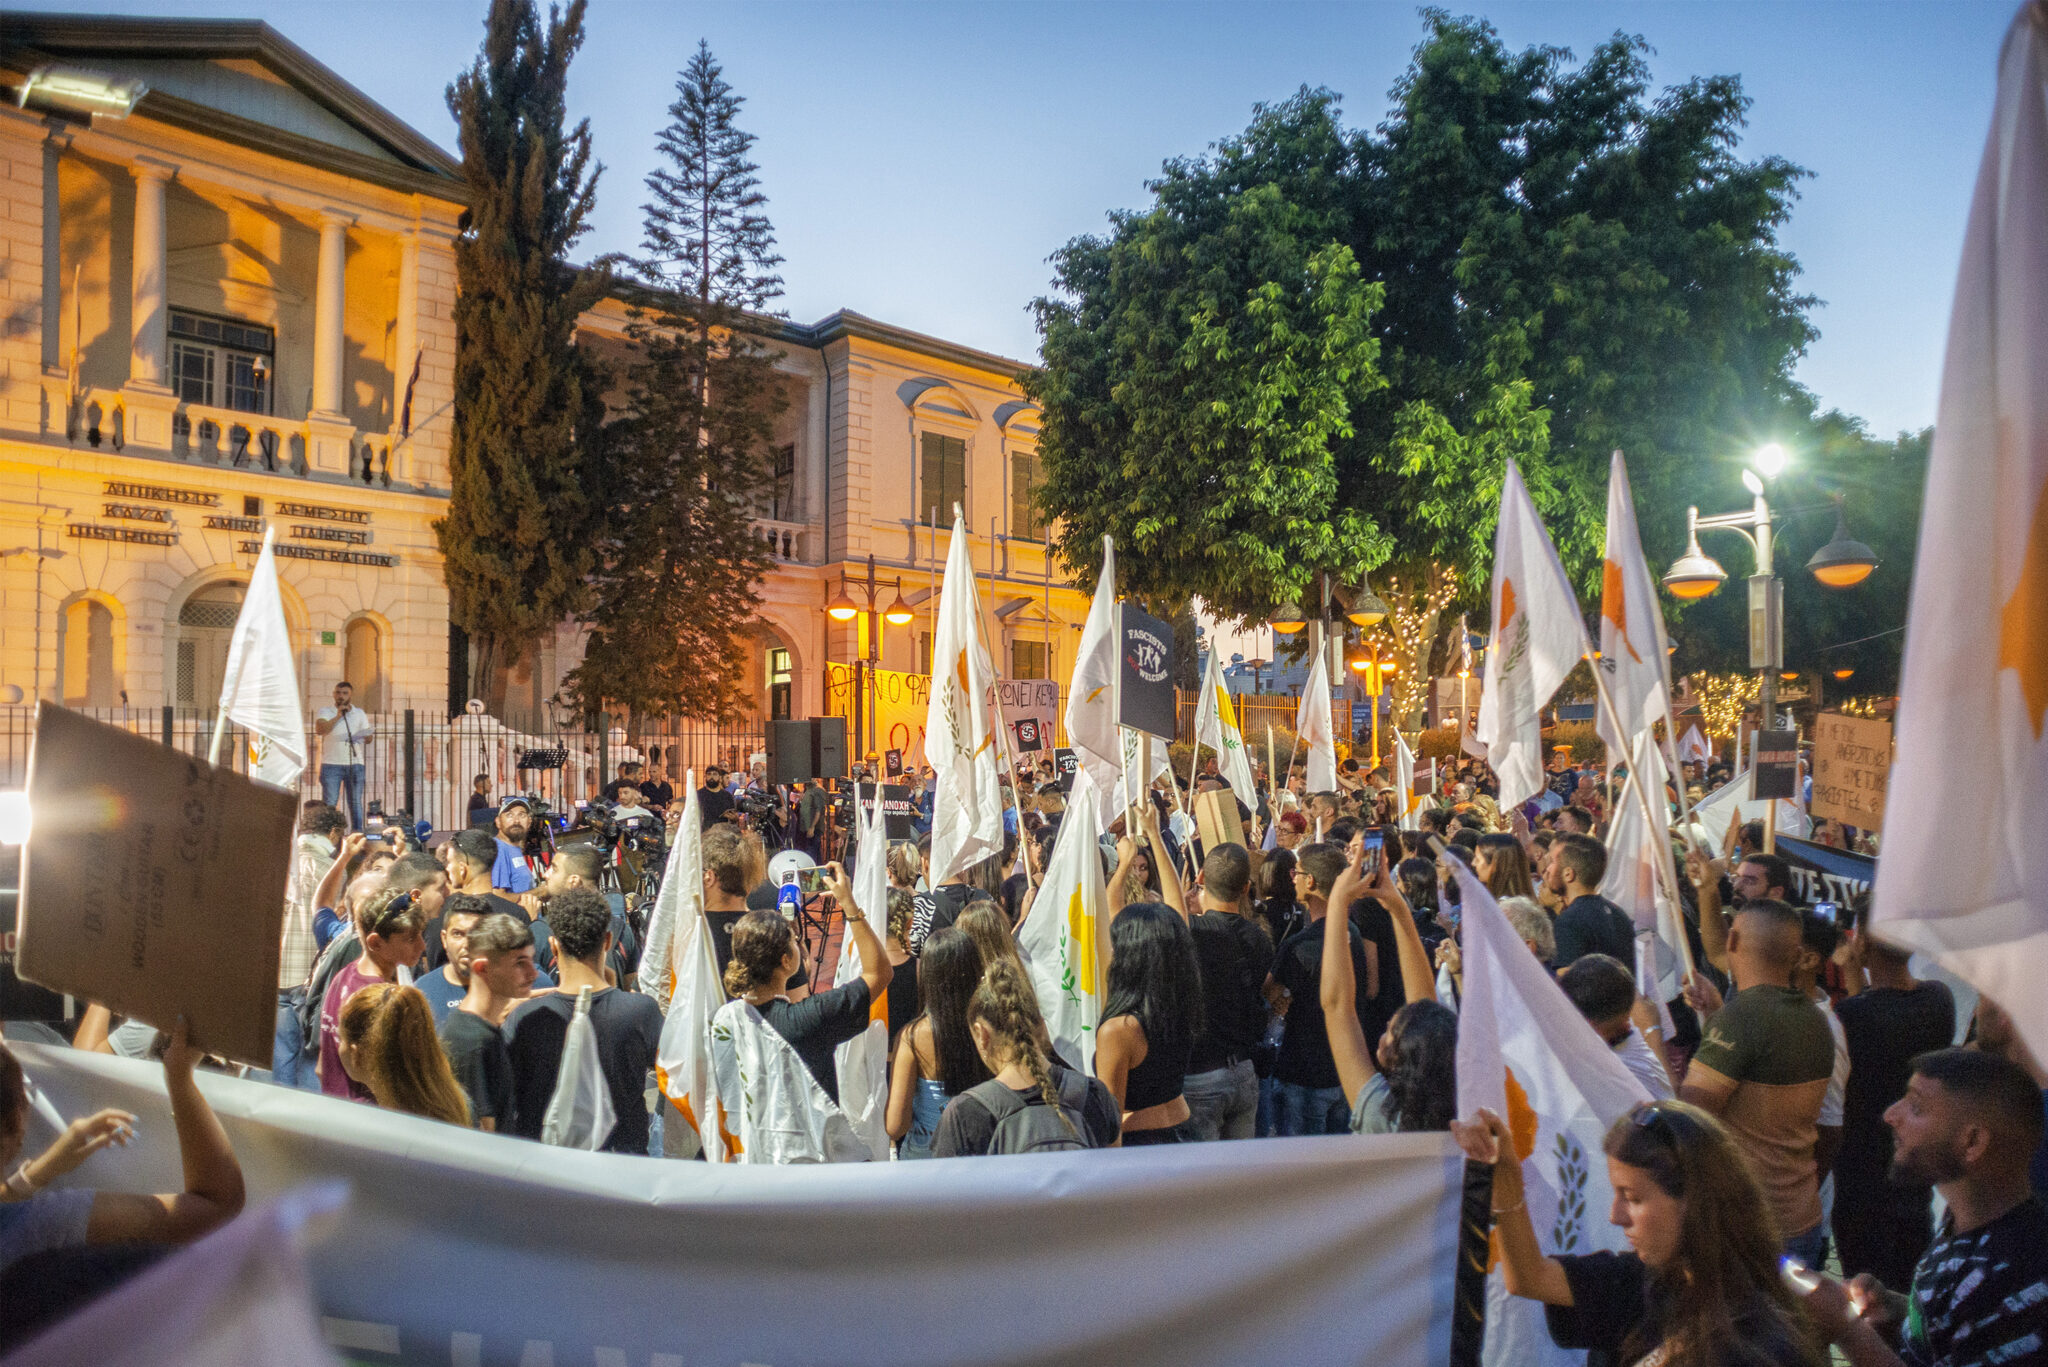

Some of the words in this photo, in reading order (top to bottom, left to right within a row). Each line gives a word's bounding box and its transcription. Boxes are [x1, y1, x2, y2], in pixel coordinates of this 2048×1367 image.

[238, 540, 393, 567] ADINISTRATION
[1128, 628, 1167, 656] FASCISTS
[1139, 668, 1169, 682] WELCOME
[884, 800, 910, 811] ΑΝΟΧΗ
